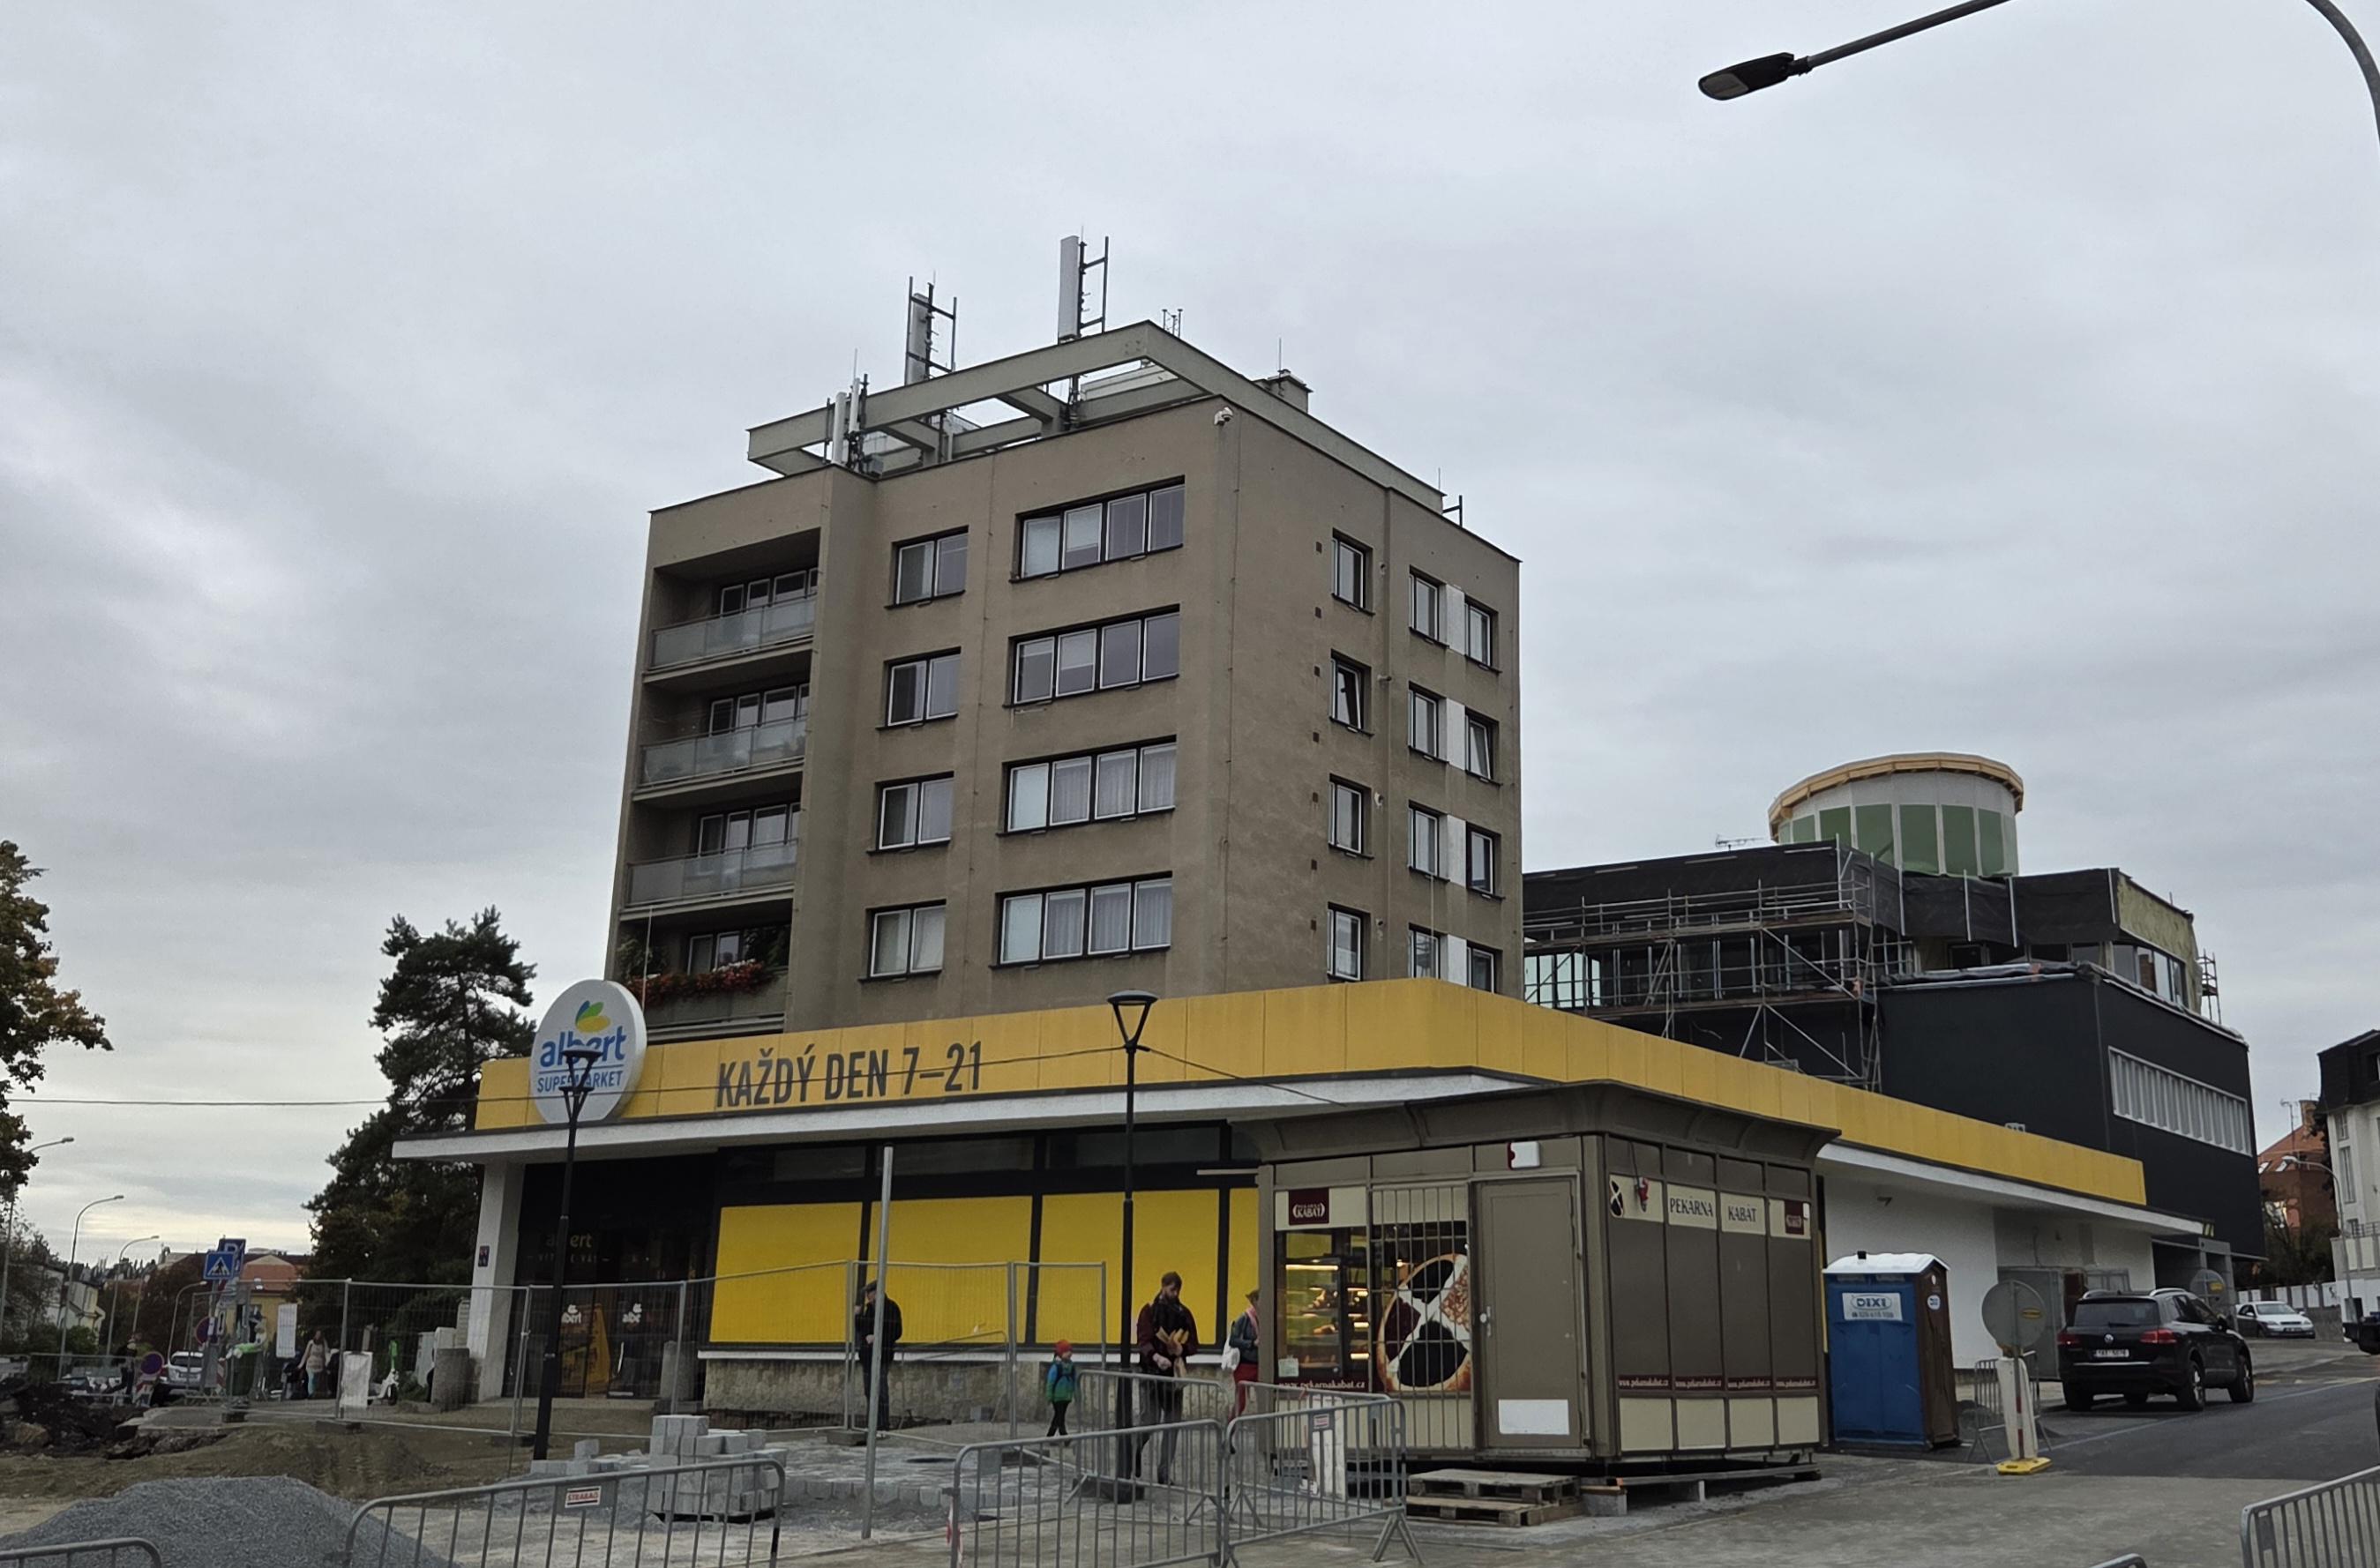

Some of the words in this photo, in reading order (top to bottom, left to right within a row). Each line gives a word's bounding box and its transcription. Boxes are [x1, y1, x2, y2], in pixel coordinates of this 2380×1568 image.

[716, 1043, 816, 1108] KAŽDÝ
[824, 1049, 889, 1101] DEN
[1670, 1196, 1713, 1217] PEKÁRNA
[1727, 1204, 1757, 1222] KABÁT
[1856, 1297, 1887, 1307] DIXI
